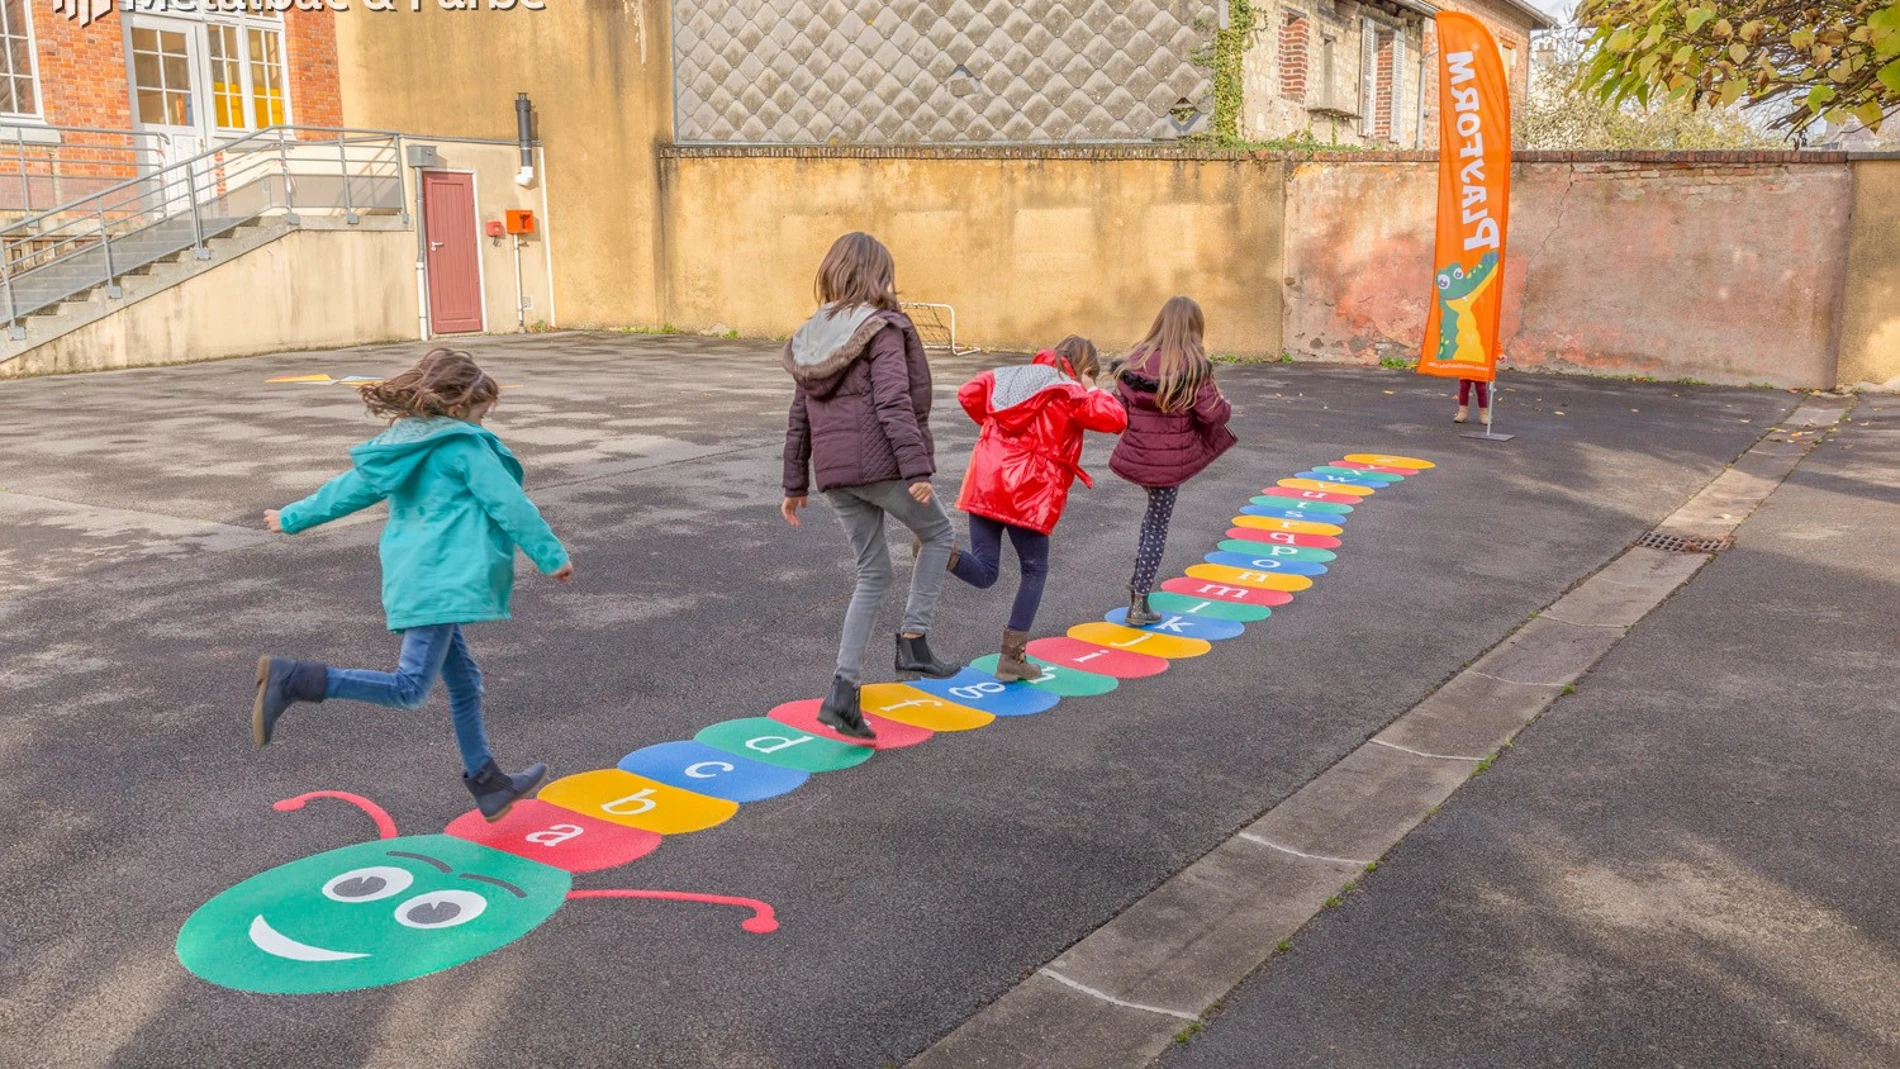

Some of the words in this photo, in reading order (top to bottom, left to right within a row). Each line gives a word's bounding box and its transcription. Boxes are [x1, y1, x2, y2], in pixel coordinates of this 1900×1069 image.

[1326, 474, 1358, 482] w
[1302, 491, 1327, 499] u
[1270, 532, 1296, 544] q
[1270, 546, 1298, 556] p
[1252, 559, 1281, 568] o
[1237, 571, 1269, 582] n
[1197, 584, 1249, 598] m
[1186, 602, 1211, 613] l
[1155, 616, 1195, 633] k
[1109, 632, 1154, 648] j
[1072, 650, 1109, 663] i
[948, 682, 1006, 699] g
[880, 698, 942, 711] f
[745, 735, 815, 754] d
[684, 761, 734, 778] c
[601, 788, 657, 815] b
[525, 824, 584, 847] a
